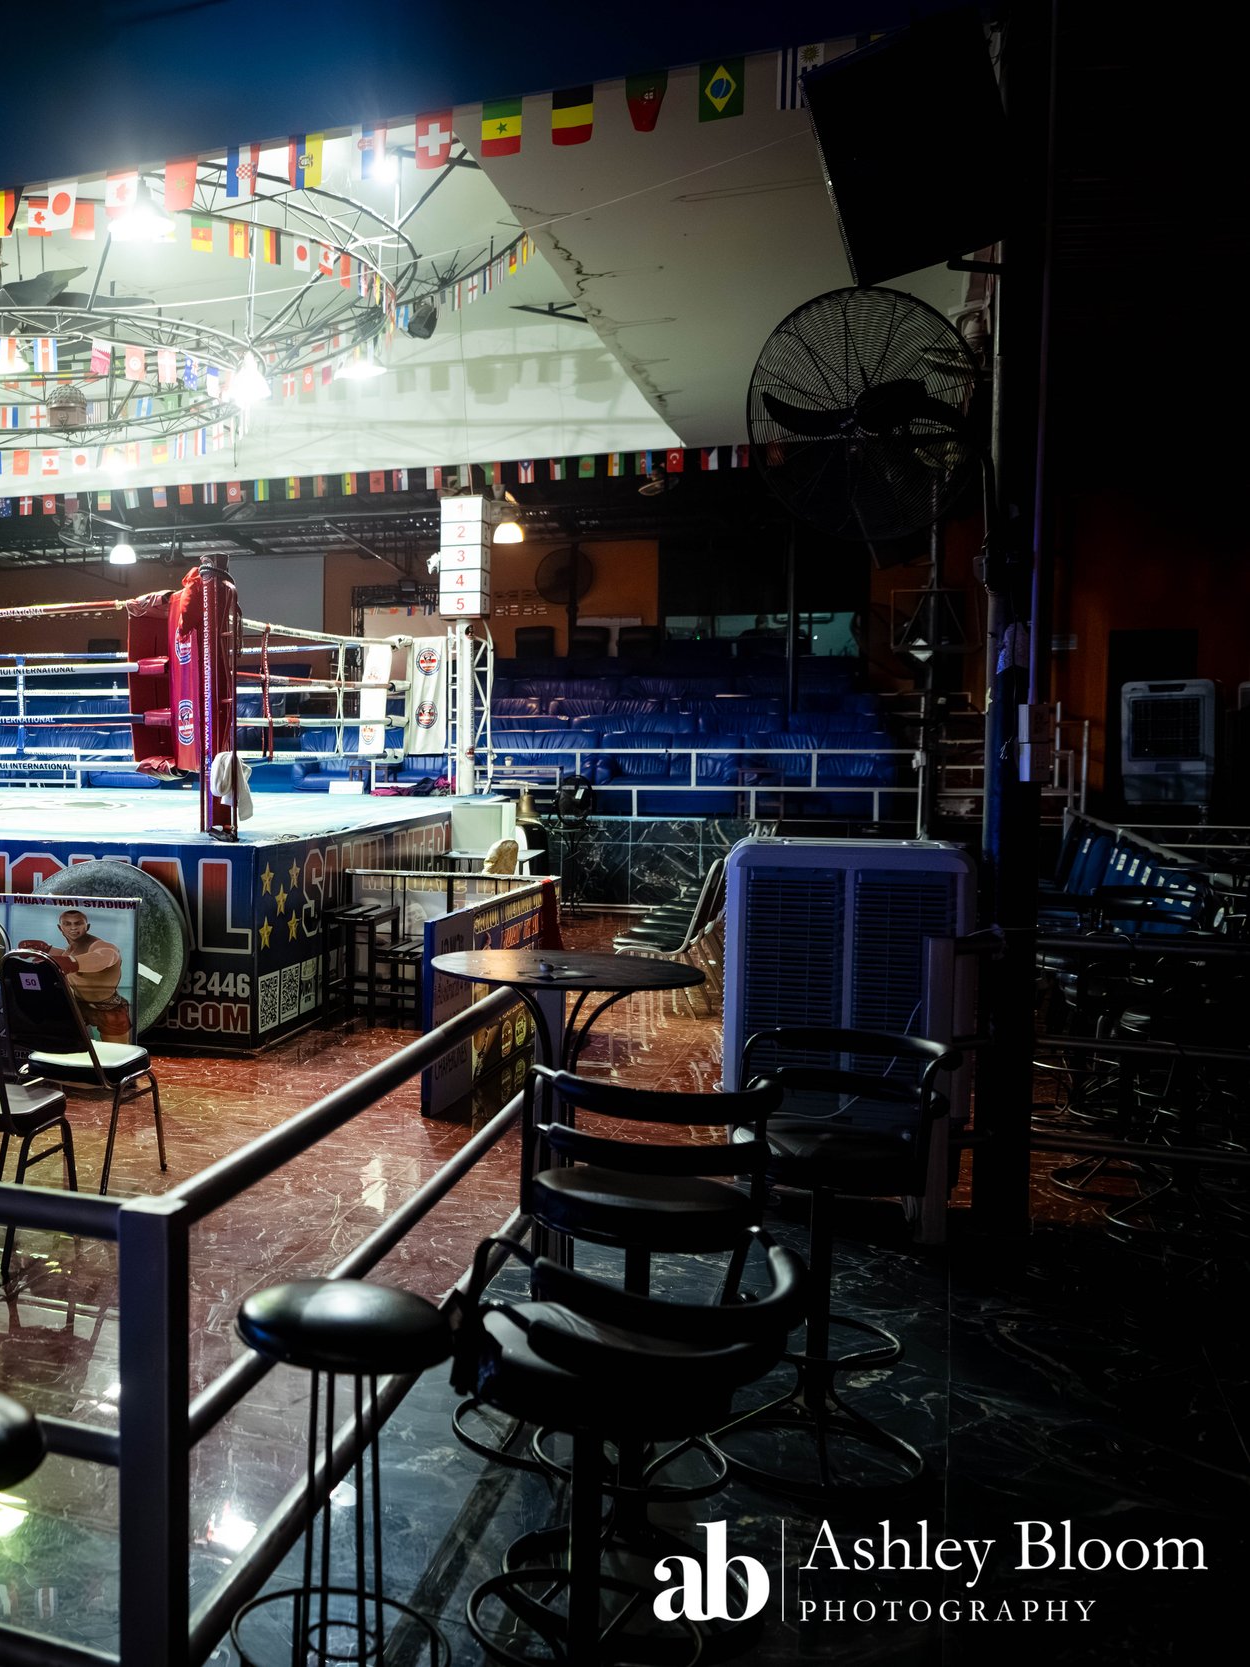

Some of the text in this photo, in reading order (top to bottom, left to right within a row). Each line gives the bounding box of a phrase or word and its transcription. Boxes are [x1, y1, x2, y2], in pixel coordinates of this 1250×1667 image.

[457, 526, 465, 538] 2
[457, 550, 465, 562] 3
[456, 574, 464, 587] 4
[456, 598, 465, 611] 5
[13, 894, 46, 906] MUAY
[52, 898, 79, 907] THAI
[83, 900, 138, 910] STADIUM
[25, 978, 37, 987] 50
